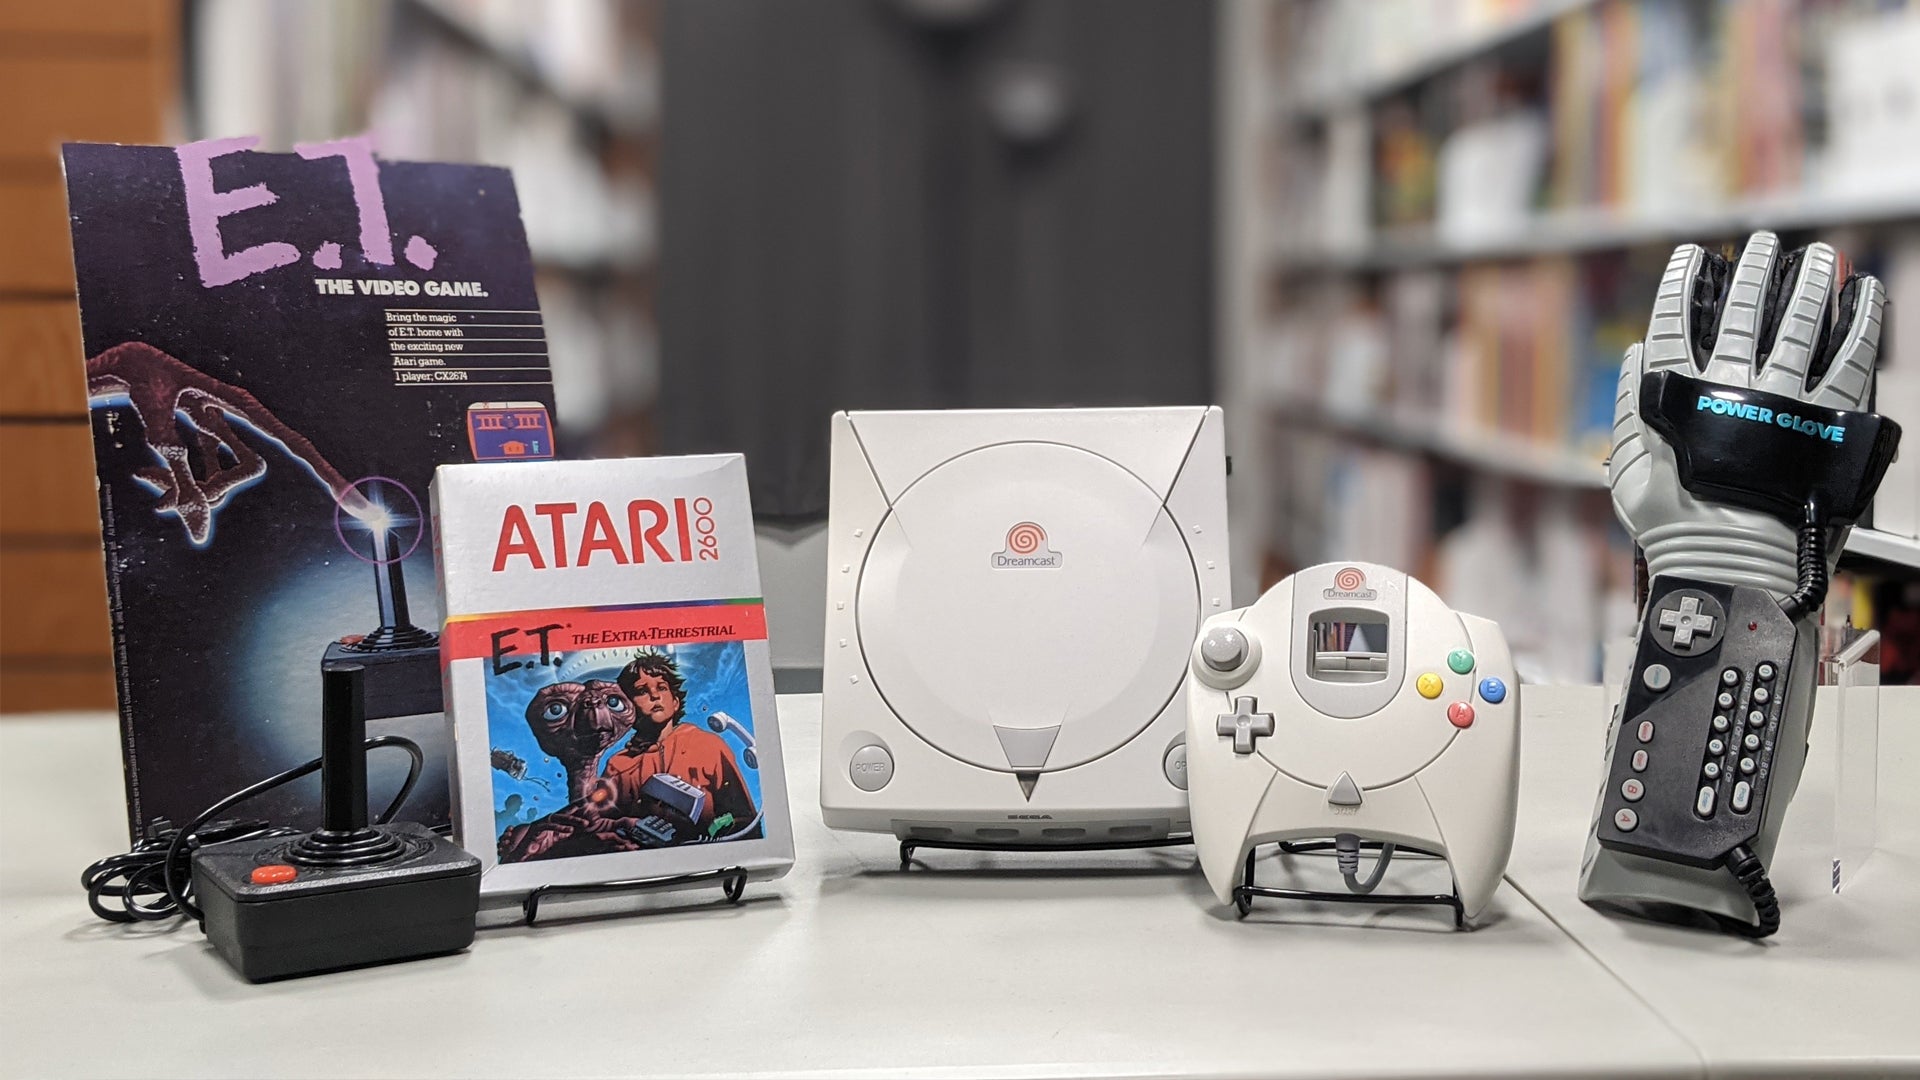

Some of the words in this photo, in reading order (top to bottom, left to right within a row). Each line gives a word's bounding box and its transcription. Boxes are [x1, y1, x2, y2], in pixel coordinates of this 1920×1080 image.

[174, 135, 438, 289] E.T.
[315, 279, 354, 295] THE
[357, 280, 420, 296] VIDEO
[424, 281, 488, 297] GAME.
[385, 312, 411, 323] Bring
[412, 313, 427, 321] the
[428, 313, 457, 323] magic
[388, 327, 397, 336] of
[399, 327, 415, 336] E.T.
[417, 327, 442, 336] home
[443, 328, 463, 337] with
[390, 342, 405, 350] the
[407, 342, 443, 352] exciting
[393, 357, 417, 366] Atari
[418, 359, 446, 367] game.
[434, 372, 468, 380] CX2674
[1697, 396, 1773, 424] POWER
[1776, 413, 1845, 442] GLOVE
[693, 497, 719, 561] 2600
[492, 498, 693, 571] ATARI
[997, 556, 1055, 566] Dreamcast
[1328, 589, 1372, 598] Dreamcast
[572, 633, 599, 645] THE
[491, 624, 564, 676] E.T.
[855, 762, 885, 772] POWER
[1175, 761, 1187, 770] OP
[1627, 784, 1638, 793] B
